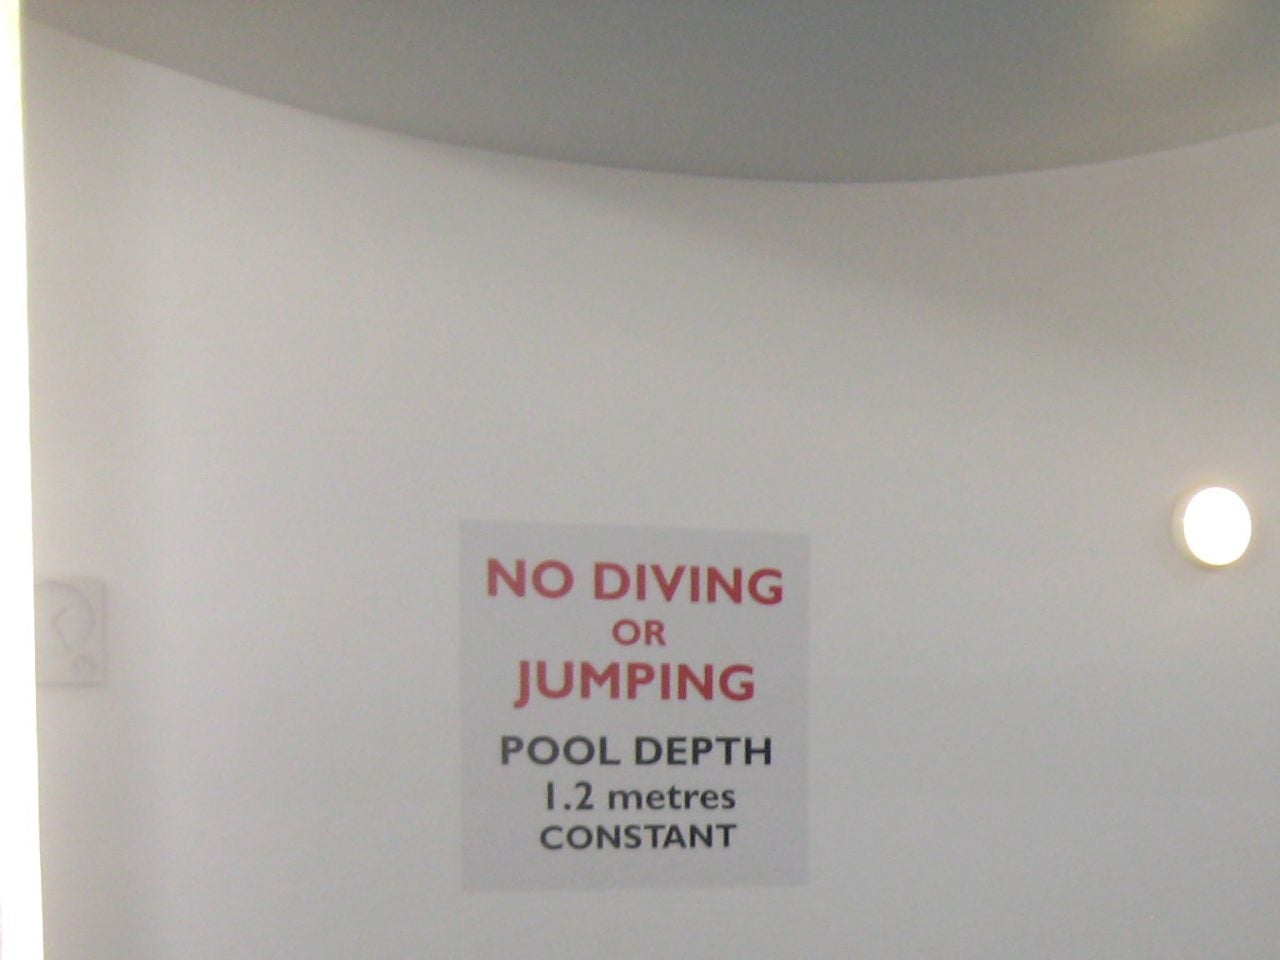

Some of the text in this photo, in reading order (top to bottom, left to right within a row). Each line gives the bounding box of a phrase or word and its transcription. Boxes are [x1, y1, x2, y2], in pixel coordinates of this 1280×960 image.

[487, 558, 784, 607] NO DIVING
[611, 618, 667, 647] OR
[513, 660, 755, 709] JUMPING
[500, 735, 772, 766] POOL DEPTH
[546, 780, 737, 811] 1.2 metres
[539, 823, 738, 851] CONSTANT
